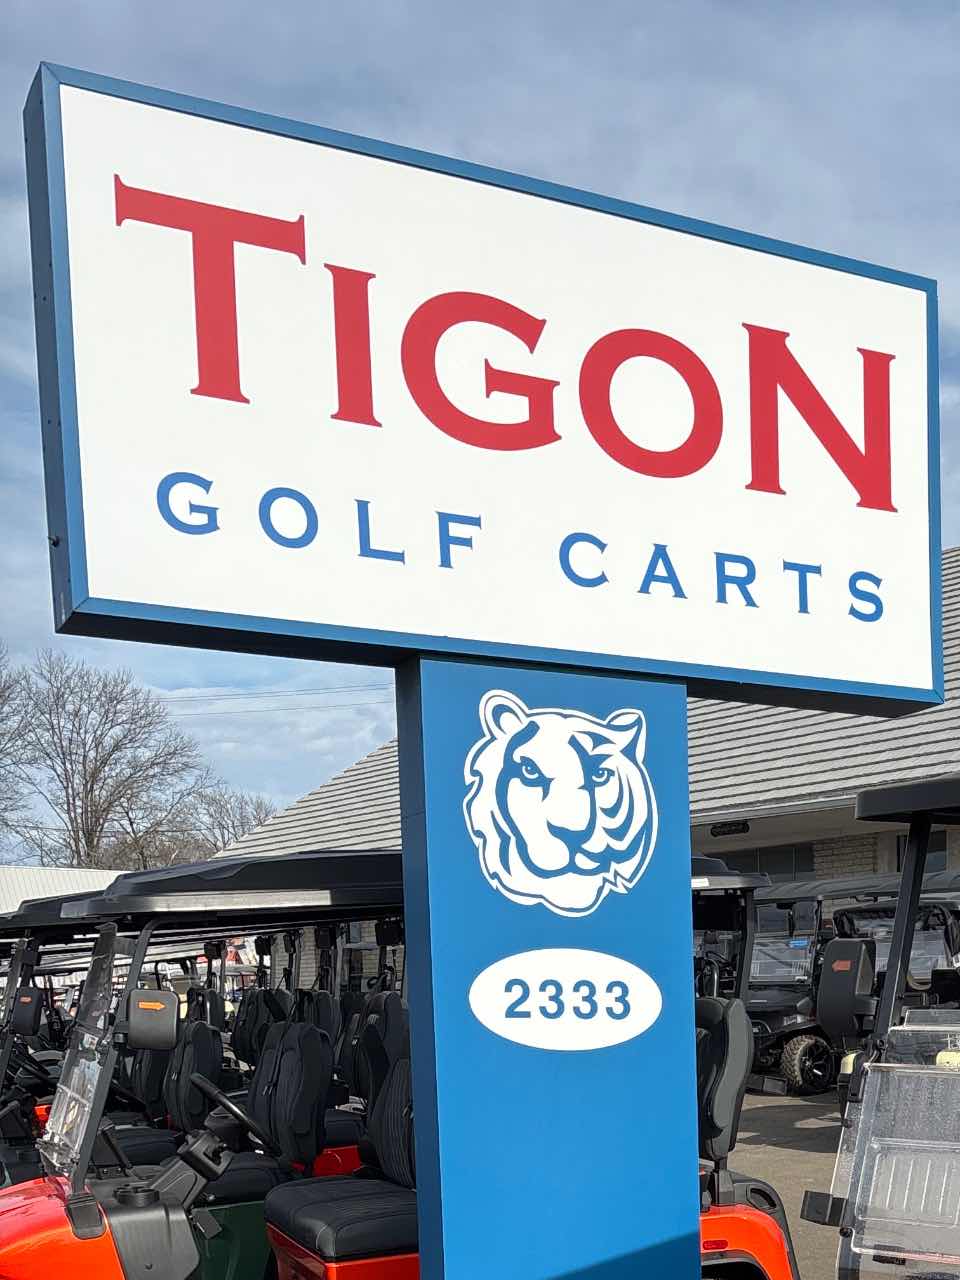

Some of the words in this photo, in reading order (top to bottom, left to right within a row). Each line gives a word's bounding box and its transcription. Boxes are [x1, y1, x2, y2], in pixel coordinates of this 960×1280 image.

[114, 175, 897, 513] TIGON
[155, 471, 482, 569] GOLF
[559, 532, 885, 623] CARTS
[504, 978, 631, 1020] 2333
